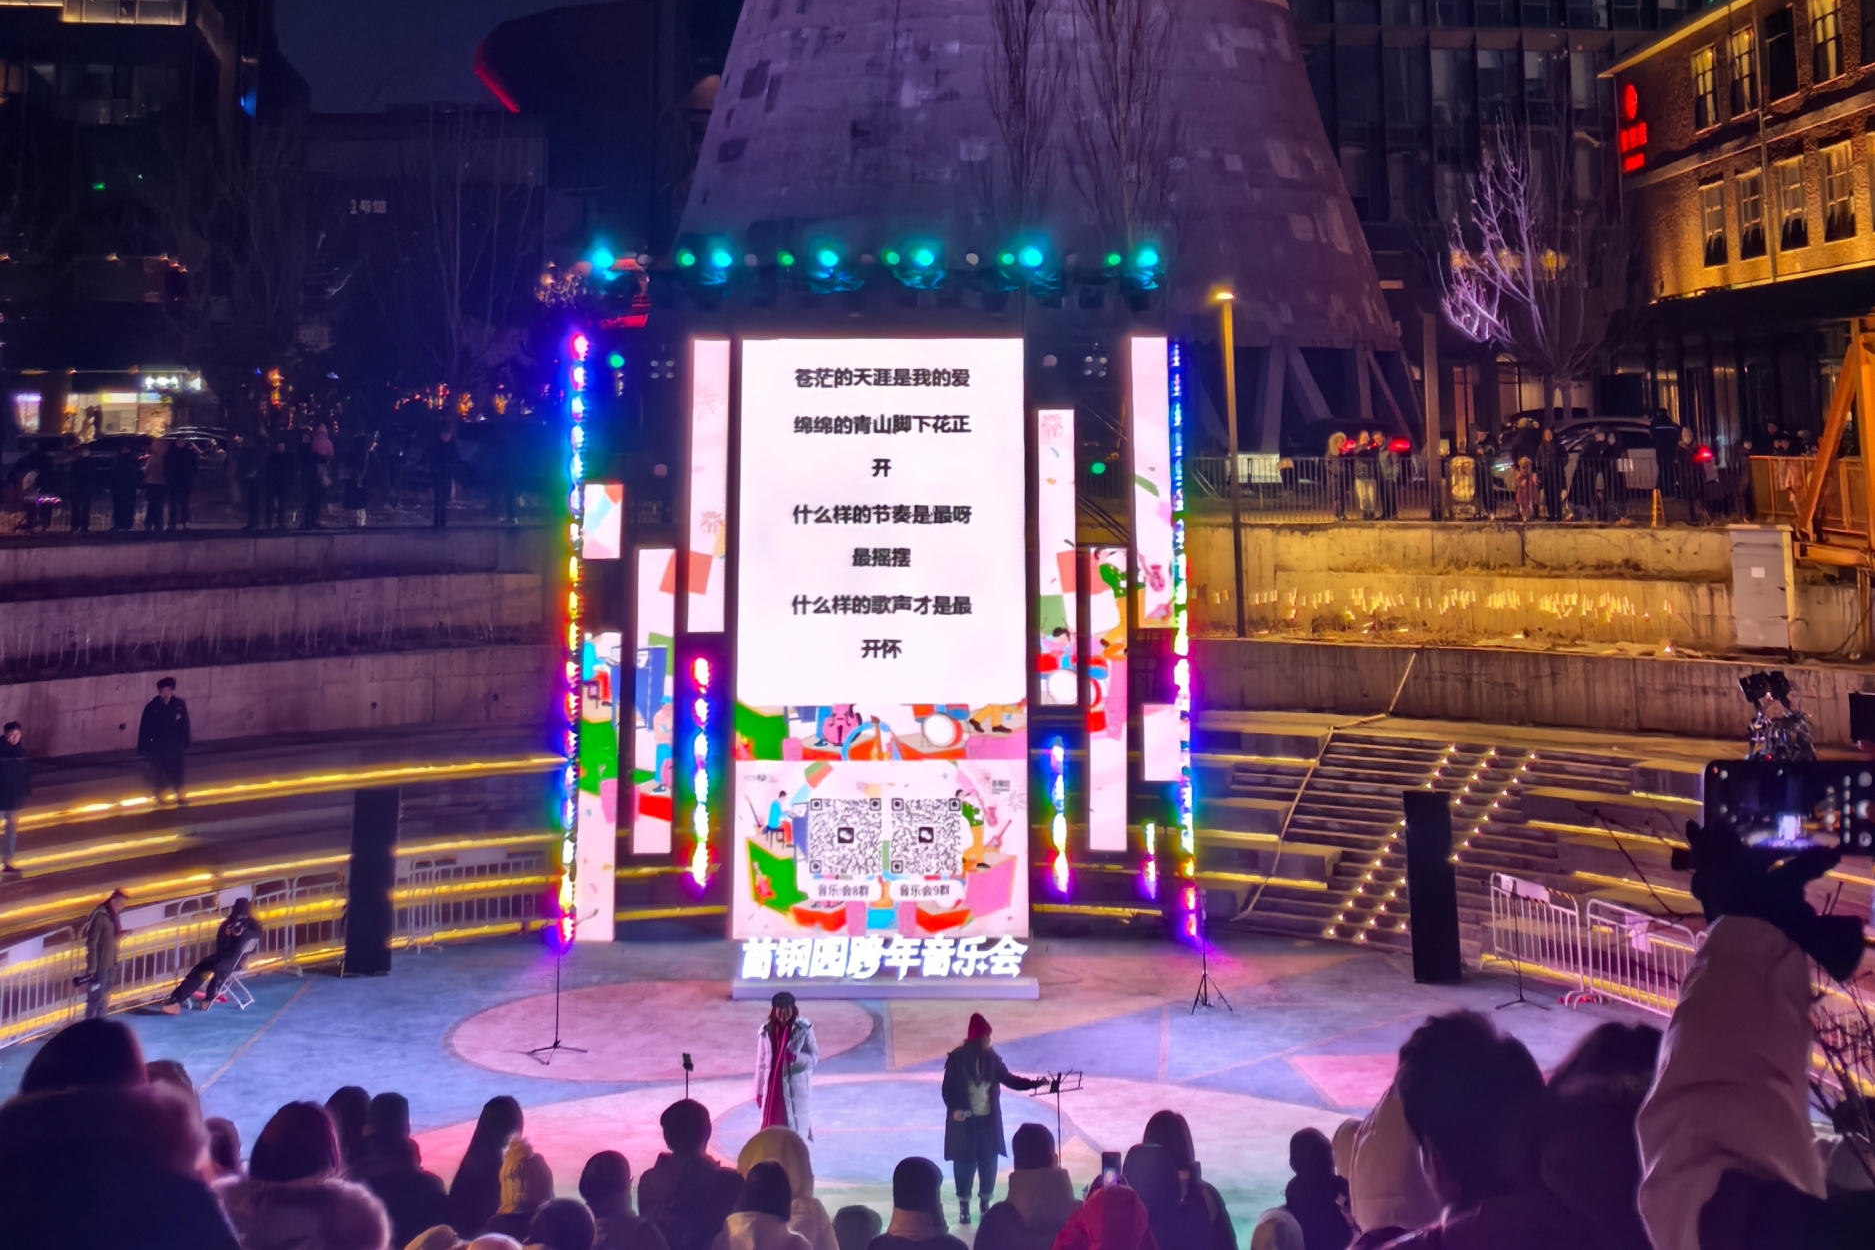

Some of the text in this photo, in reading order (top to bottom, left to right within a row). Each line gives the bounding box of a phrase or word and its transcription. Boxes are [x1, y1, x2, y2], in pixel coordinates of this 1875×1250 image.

[794, 367, 970, 388] 苍茫的天涯是我的爱
[793, 414, 972, 435] 绵绵的青山脚下花正
[872, 458, 892, 477] 开
[792, 504, 972, 525] 什么样的节奏是最呀
[852, 547, 911, 568] 最摇摆
[792, 595, 972, 615] 什么样的歌声才是最
[861, 639, 902, 659] 开怀
[742, 935, 1027, 979] 首钢园跨年音乐会
